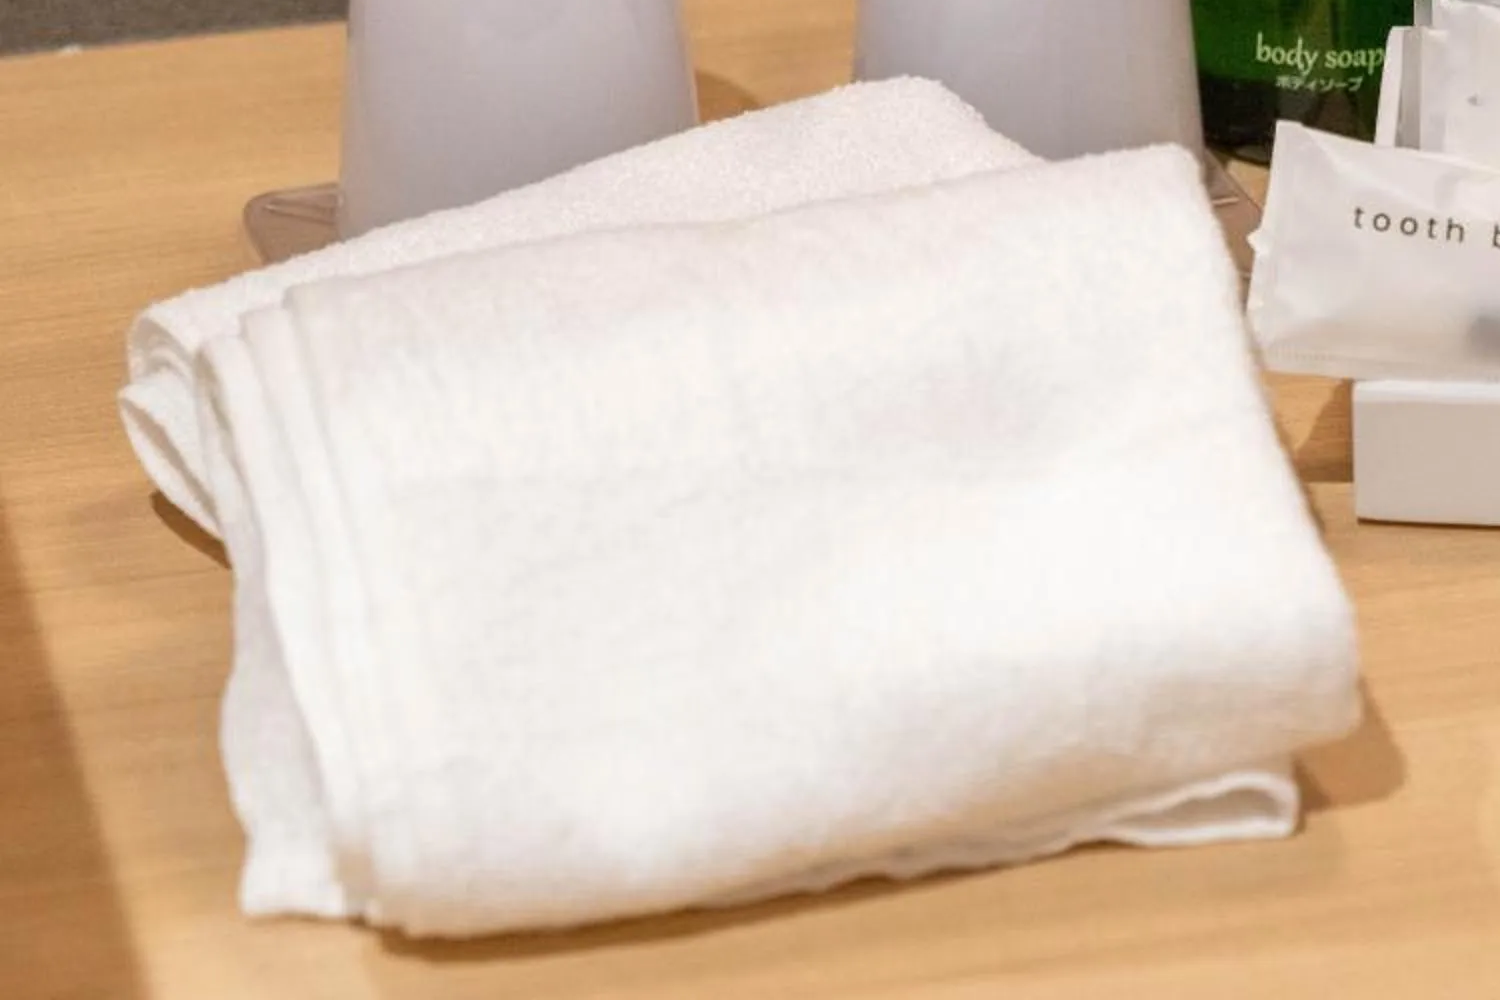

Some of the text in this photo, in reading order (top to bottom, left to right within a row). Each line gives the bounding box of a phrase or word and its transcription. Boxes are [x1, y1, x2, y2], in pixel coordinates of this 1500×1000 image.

[1256, 31, 1385, 77] body soap
[1275, 74, 1364, 93] ボディソープ
[1353, 206, 1466, 244] tooth
